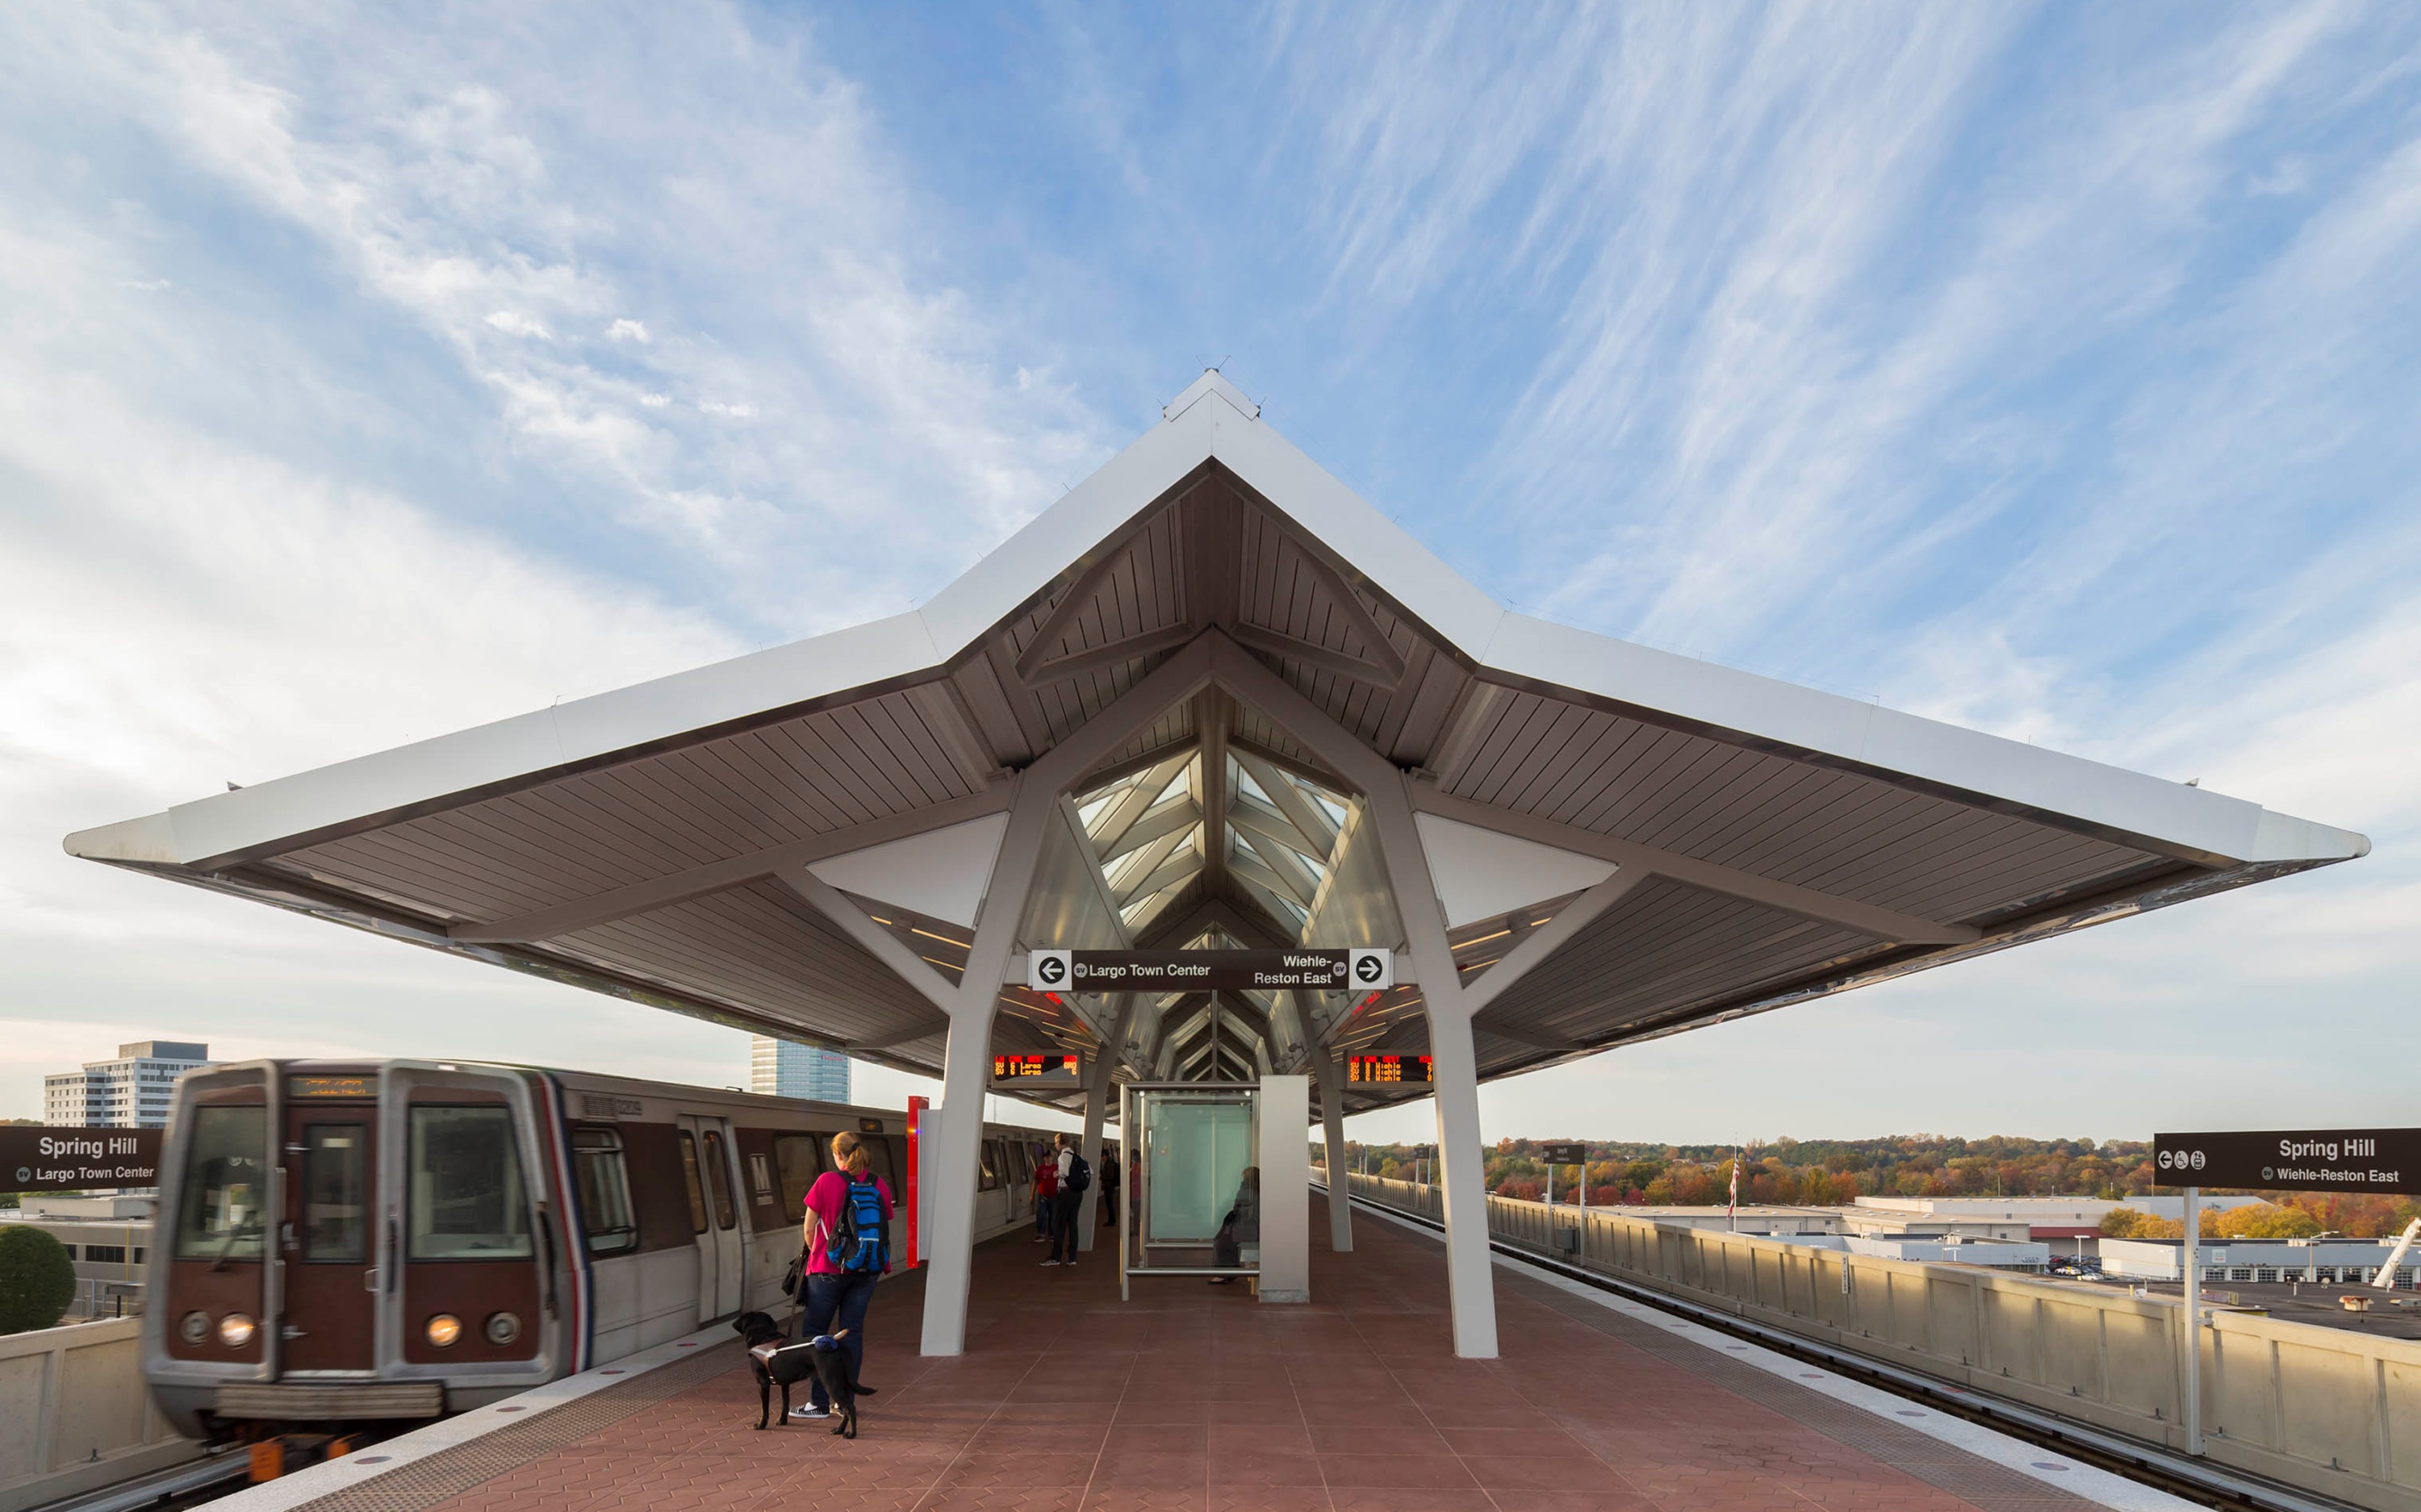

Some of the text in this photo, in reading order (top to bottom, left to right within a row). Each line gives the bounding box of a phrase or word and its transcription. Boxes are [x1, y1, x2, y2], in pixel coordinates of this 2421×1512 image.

[1283, 955, 1332, 967] Wiehle-
[1089, 964, 1127, 979] Largo
[1130, 964, 1163, 976] Town
[1167, 964, 1210, 976] Center
[1255, 972, 1332, 984] Reston East
[40, 1136, 137, 1159] Spring Hill
[2280, 1138, 2375, 1161] Spring Hill
[36, 1167, 75, 1183] Largo
[78, 1167, 112, 1180] Town
[115, 1166, 154, 1178] Center
[2277, 1168, 2365, 1181] Wiehle-Reston
[2369, 1170, 2399, 1183] East
